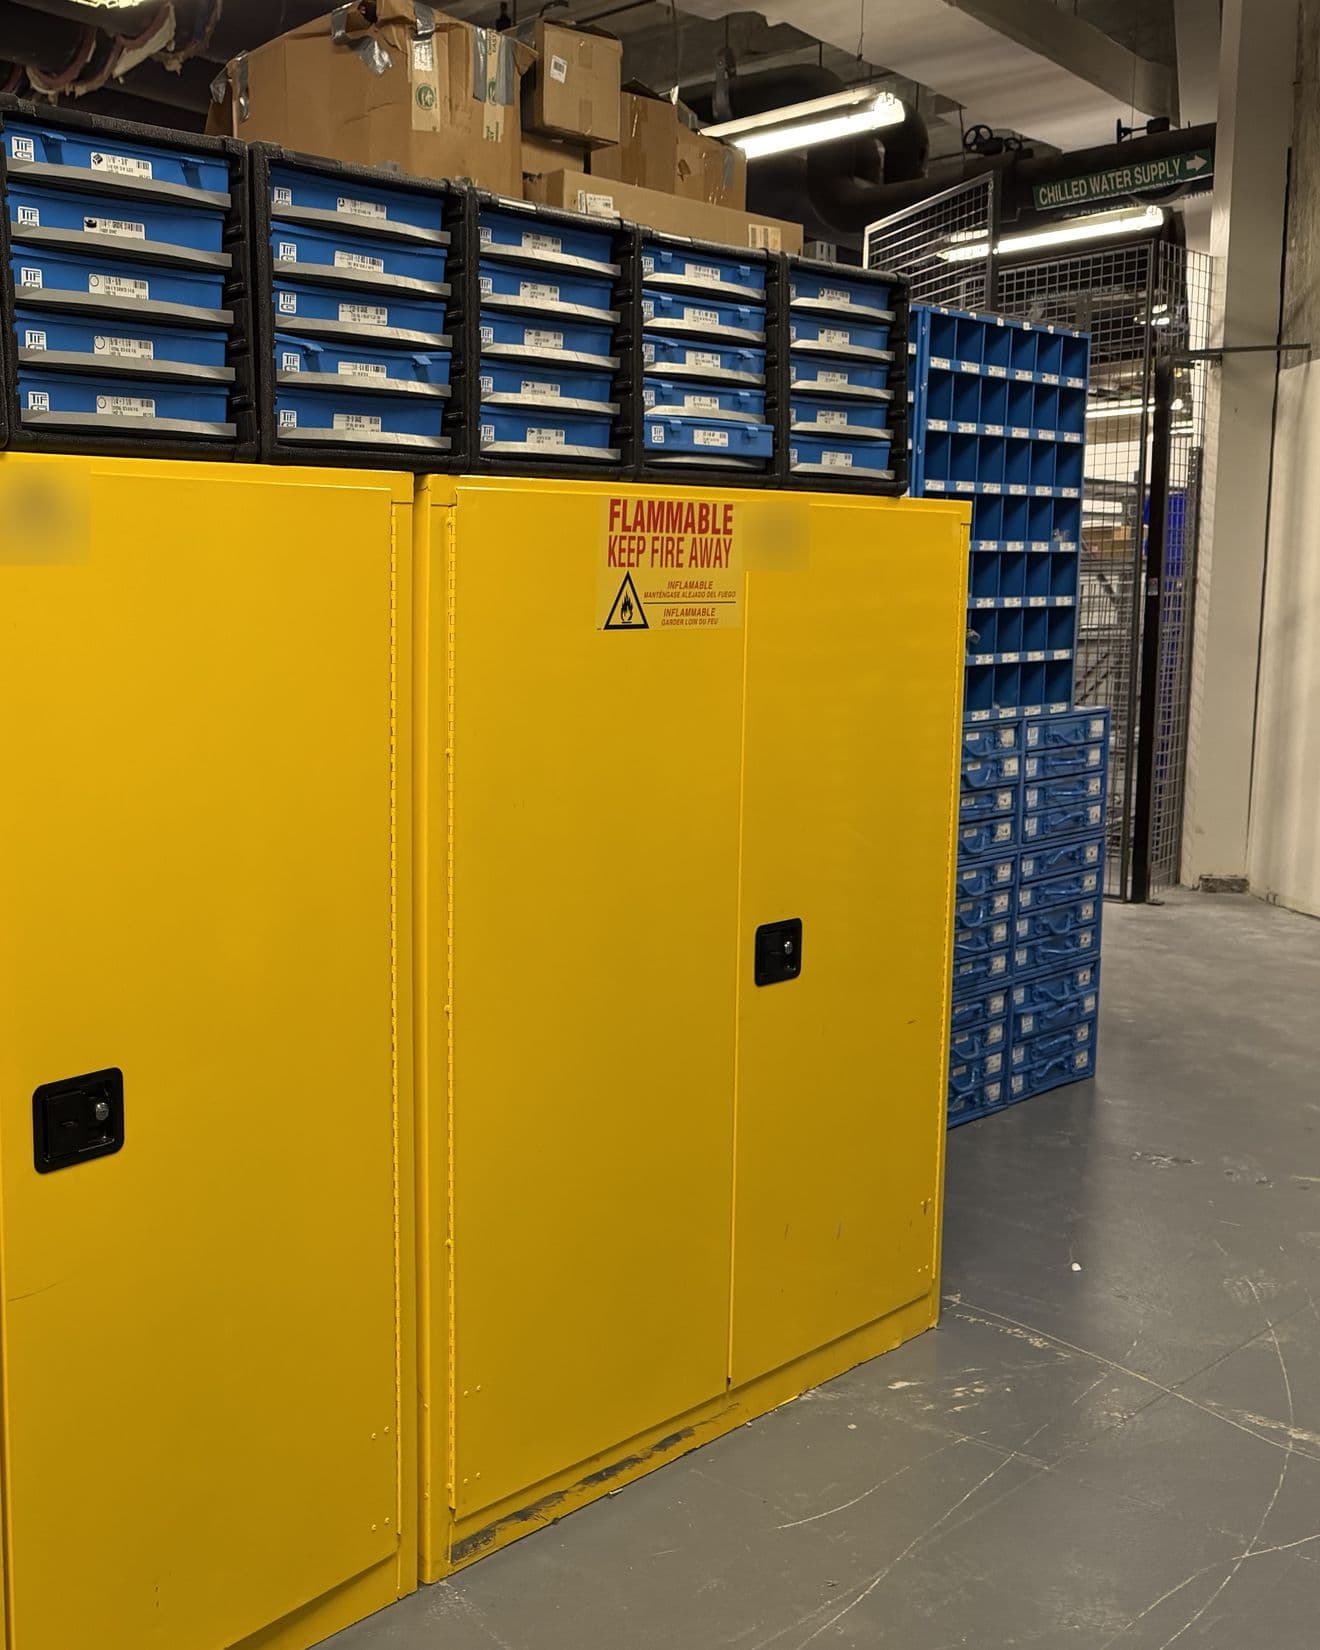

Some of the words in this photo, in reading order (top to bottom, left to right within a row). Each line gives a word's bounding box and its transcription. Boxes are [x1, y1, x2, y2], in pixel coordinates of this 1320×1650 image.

[1039, 179, 1087, 205] CHILLED
[1090, 169, 1132, 194] WATER
[1134, 158, 1181, 184] SUPPLY
[609, 498, 734, 535] FLAMMABLE
[608, 536, 646, 568] KEEP
[651, 536, 684, 568] FIRE
[689, 538, 732, 568] AWAY
[667, 581, 713, 590] INFLAMABLE
[662, 618, 683, 626] GARDER
[685, 618, 697, 626] LOIN
[664, 608, 715, 617] INFLAMMABLE
